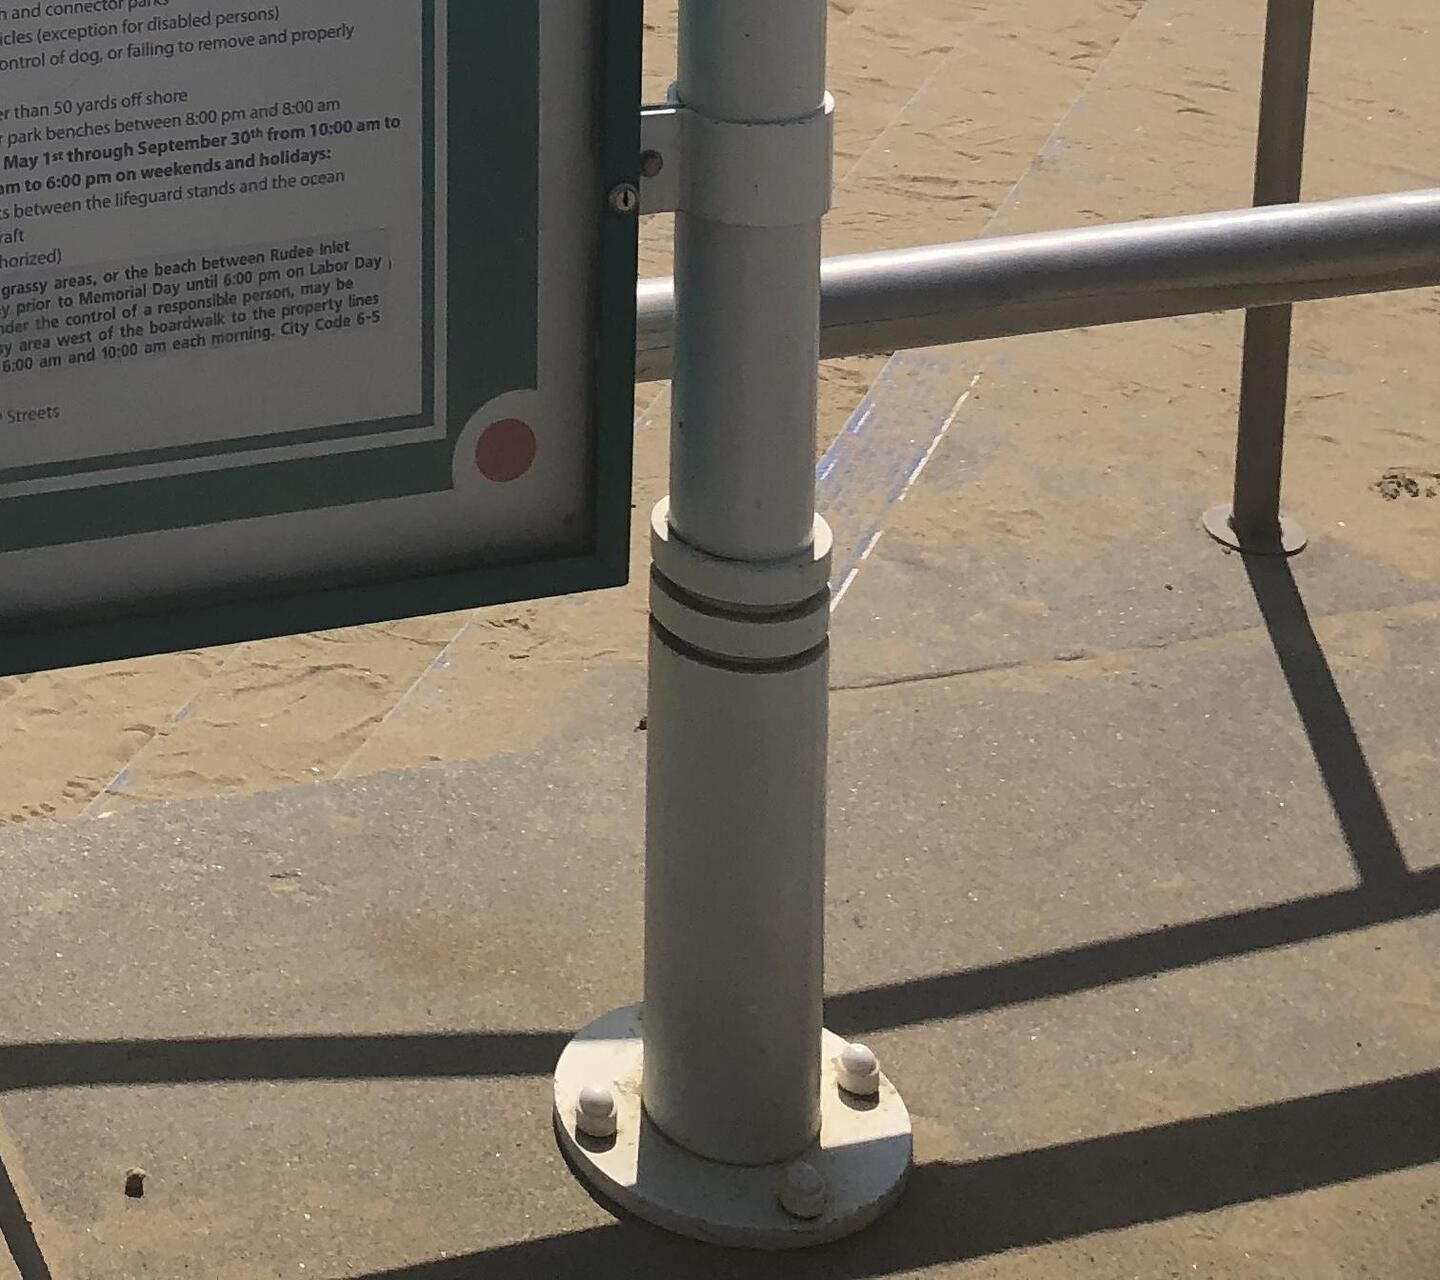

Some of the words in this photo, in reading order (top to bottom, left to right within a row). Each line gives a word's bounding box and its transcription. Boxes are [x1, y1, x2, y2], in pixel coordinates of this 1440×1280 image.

[3, 153, 39, 172] May
[42, 151, 64, 166] 1st
[66, 141, 134, 164] through
[137, 133, 228, 158] September
[230, 127, 264, 146] 30th
[267, 125, 306, 143] from
[309, 119, 353, 138] 10:00
[356, 119, 381, 133] am
[384, 116, 401, 130] to
[6, 405, 60, 424] Streets
